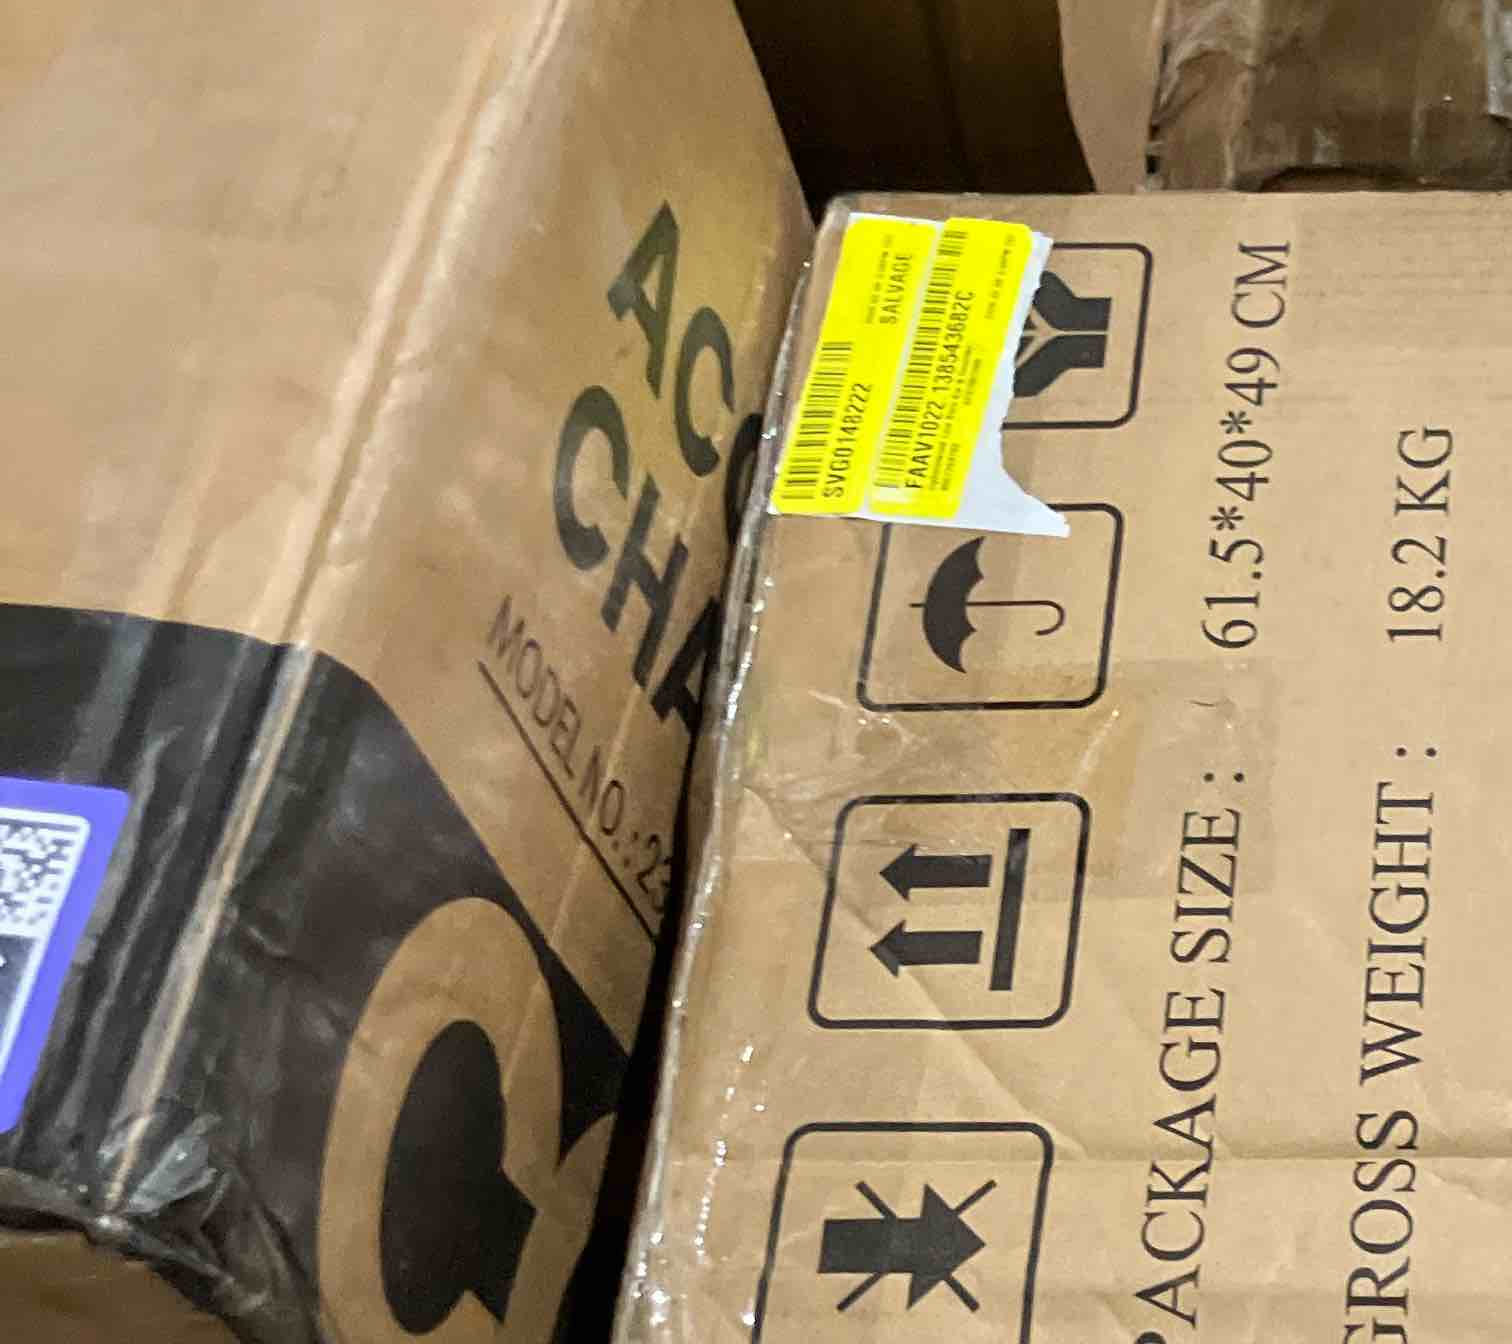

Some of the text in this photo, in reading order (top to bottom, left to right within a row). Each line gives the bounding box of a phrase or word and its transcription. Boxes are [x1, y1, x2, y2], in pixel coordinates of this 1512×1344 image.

[880, 253, 913, 325] SALVAGE
[1231, 240, 1291, 329] CM
[823, 382, 872, 499] SVG0148222
[905, 400, 945, 489] FAAV1022
[1386, 425, 1455, 643] 18.2 KG
[487, 593, 582, 782] MODEL
